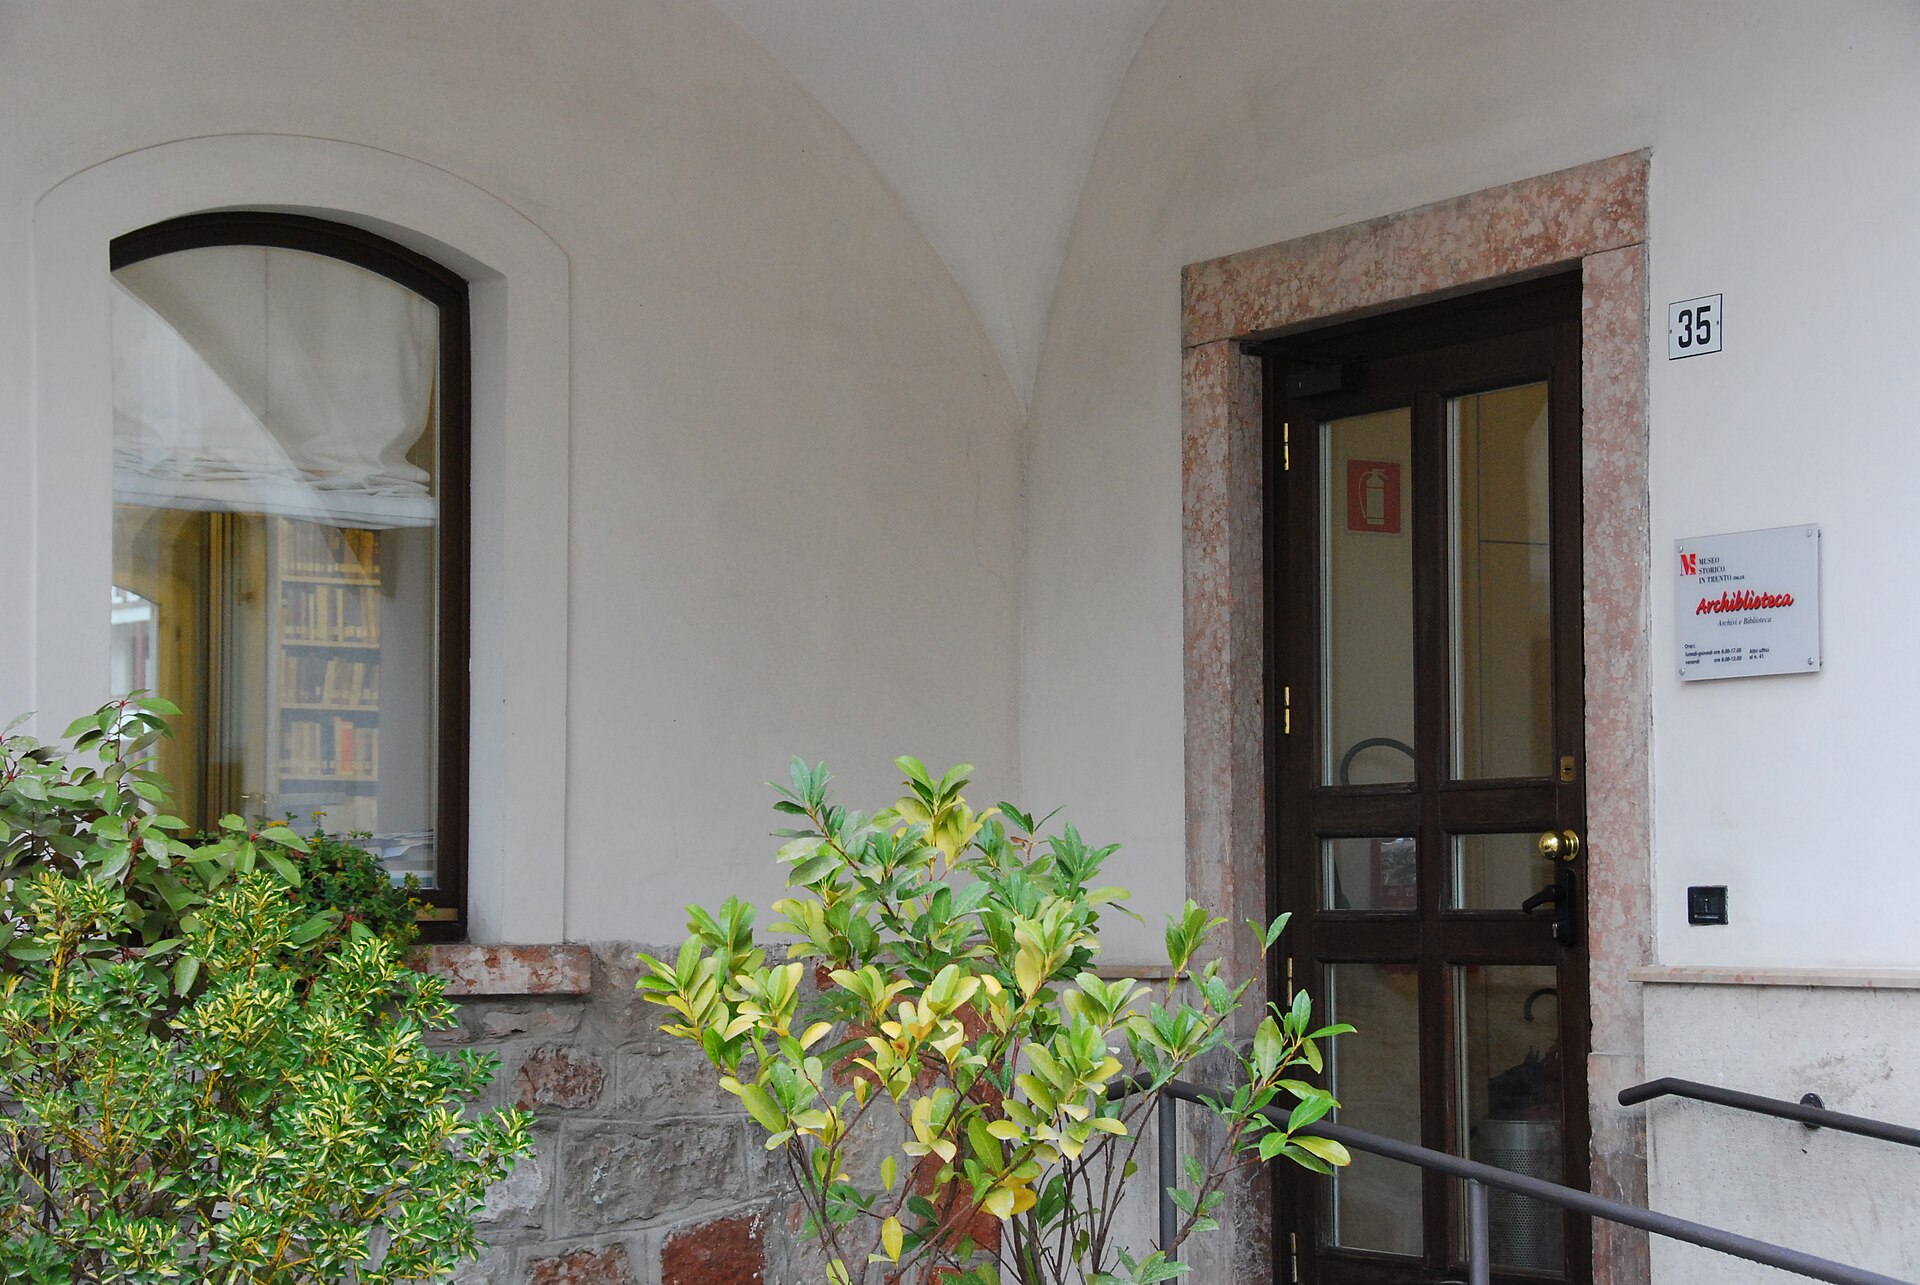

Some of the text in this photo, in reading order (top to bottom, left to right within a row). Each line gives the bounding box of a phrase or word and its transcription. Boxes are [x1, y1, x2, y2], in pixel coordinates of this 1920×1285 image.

[1678, 305, 1711, 349] 35
[1699, 557, 1720, 565] MUSEO
[1699, 566, 1726, 575] STORICO
[1707, 575, 1732, 583] TRENTO
[1695, 589, 1795, 616] Archiblioteca
[1743, 617, 1771, 625] Biblioteca
